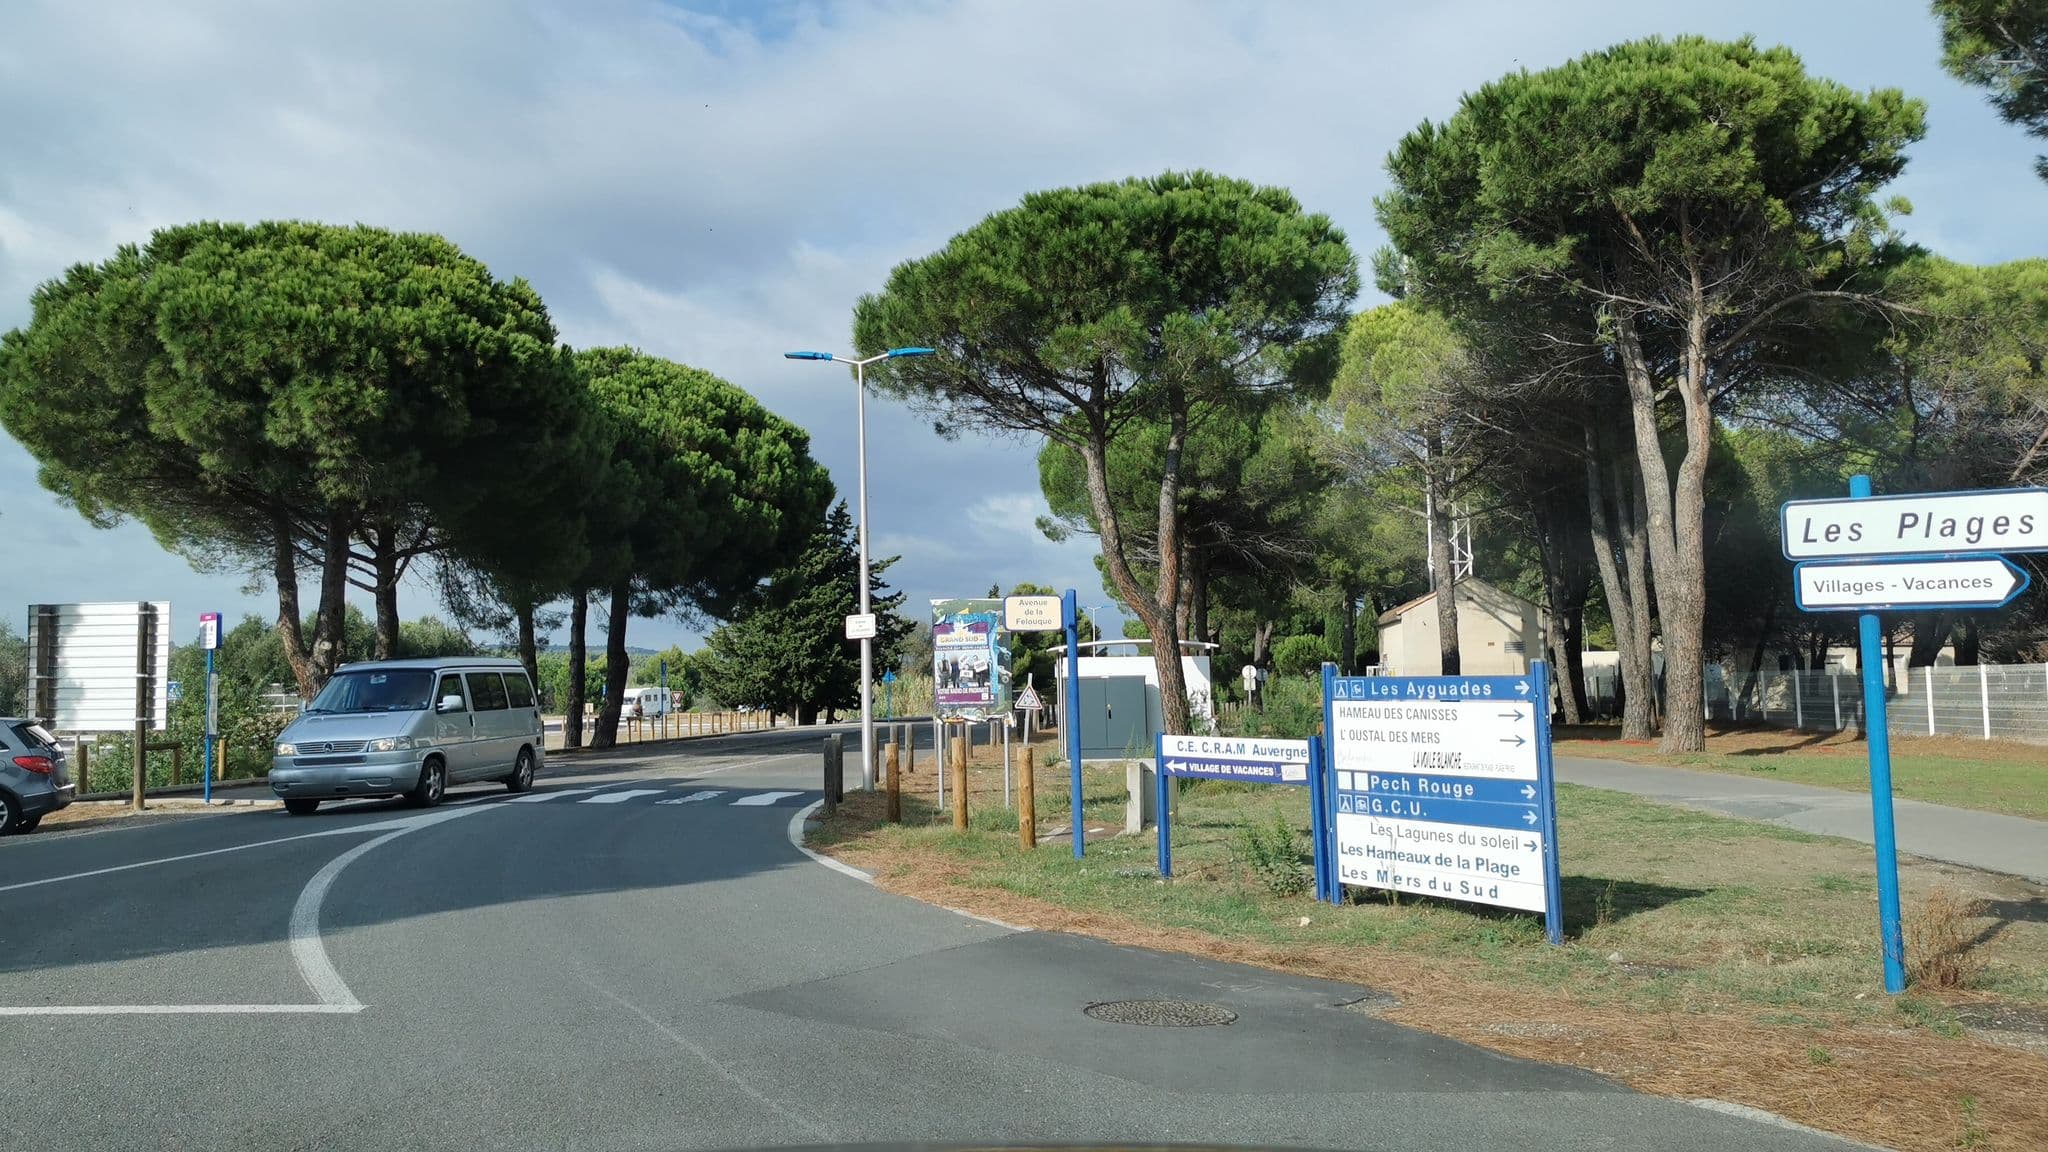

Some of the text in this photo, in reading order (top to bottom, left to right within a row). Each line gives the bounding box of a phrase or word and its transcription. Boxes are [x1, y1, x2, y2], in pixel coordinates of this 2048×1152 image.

[1802, 512, 2035, 544] Les Plages
[1813, 578, 1885, 596] Villages
[1902, 575, 1993, 591] Vacances
[1024, 608, 1043, 616] de la
[1015, 617, 1053, 626] Felouque
[1371, 681, 1492, 699] Les Ayguades
[1339, 706, 1458, 721] HAMEAU DES CANISSES
[1348, 729, 1385, 742] OUSTAL
[1388, 731, 1408, 743] DES
[1411, 731, 1441, 744] MERS
[1252, 743, 1308, 760] Auvergne
[1189, 763, 1220, 773] VILLAGE
[1221, 764, 1232, 775] DE
[1233, 765, 1275, 777] VACANCES
[1370, 774, 1474, 798] Pech Rouge
[1371, 798, 1428, 817] G.C.U.
[1370, 821, 1519, 850] Les Lagunes du soleil
[1340, 841, 1521, 878] Les Hameaux de la Plage
[1341, 864, 1499, 900] Les Mers du Sud
